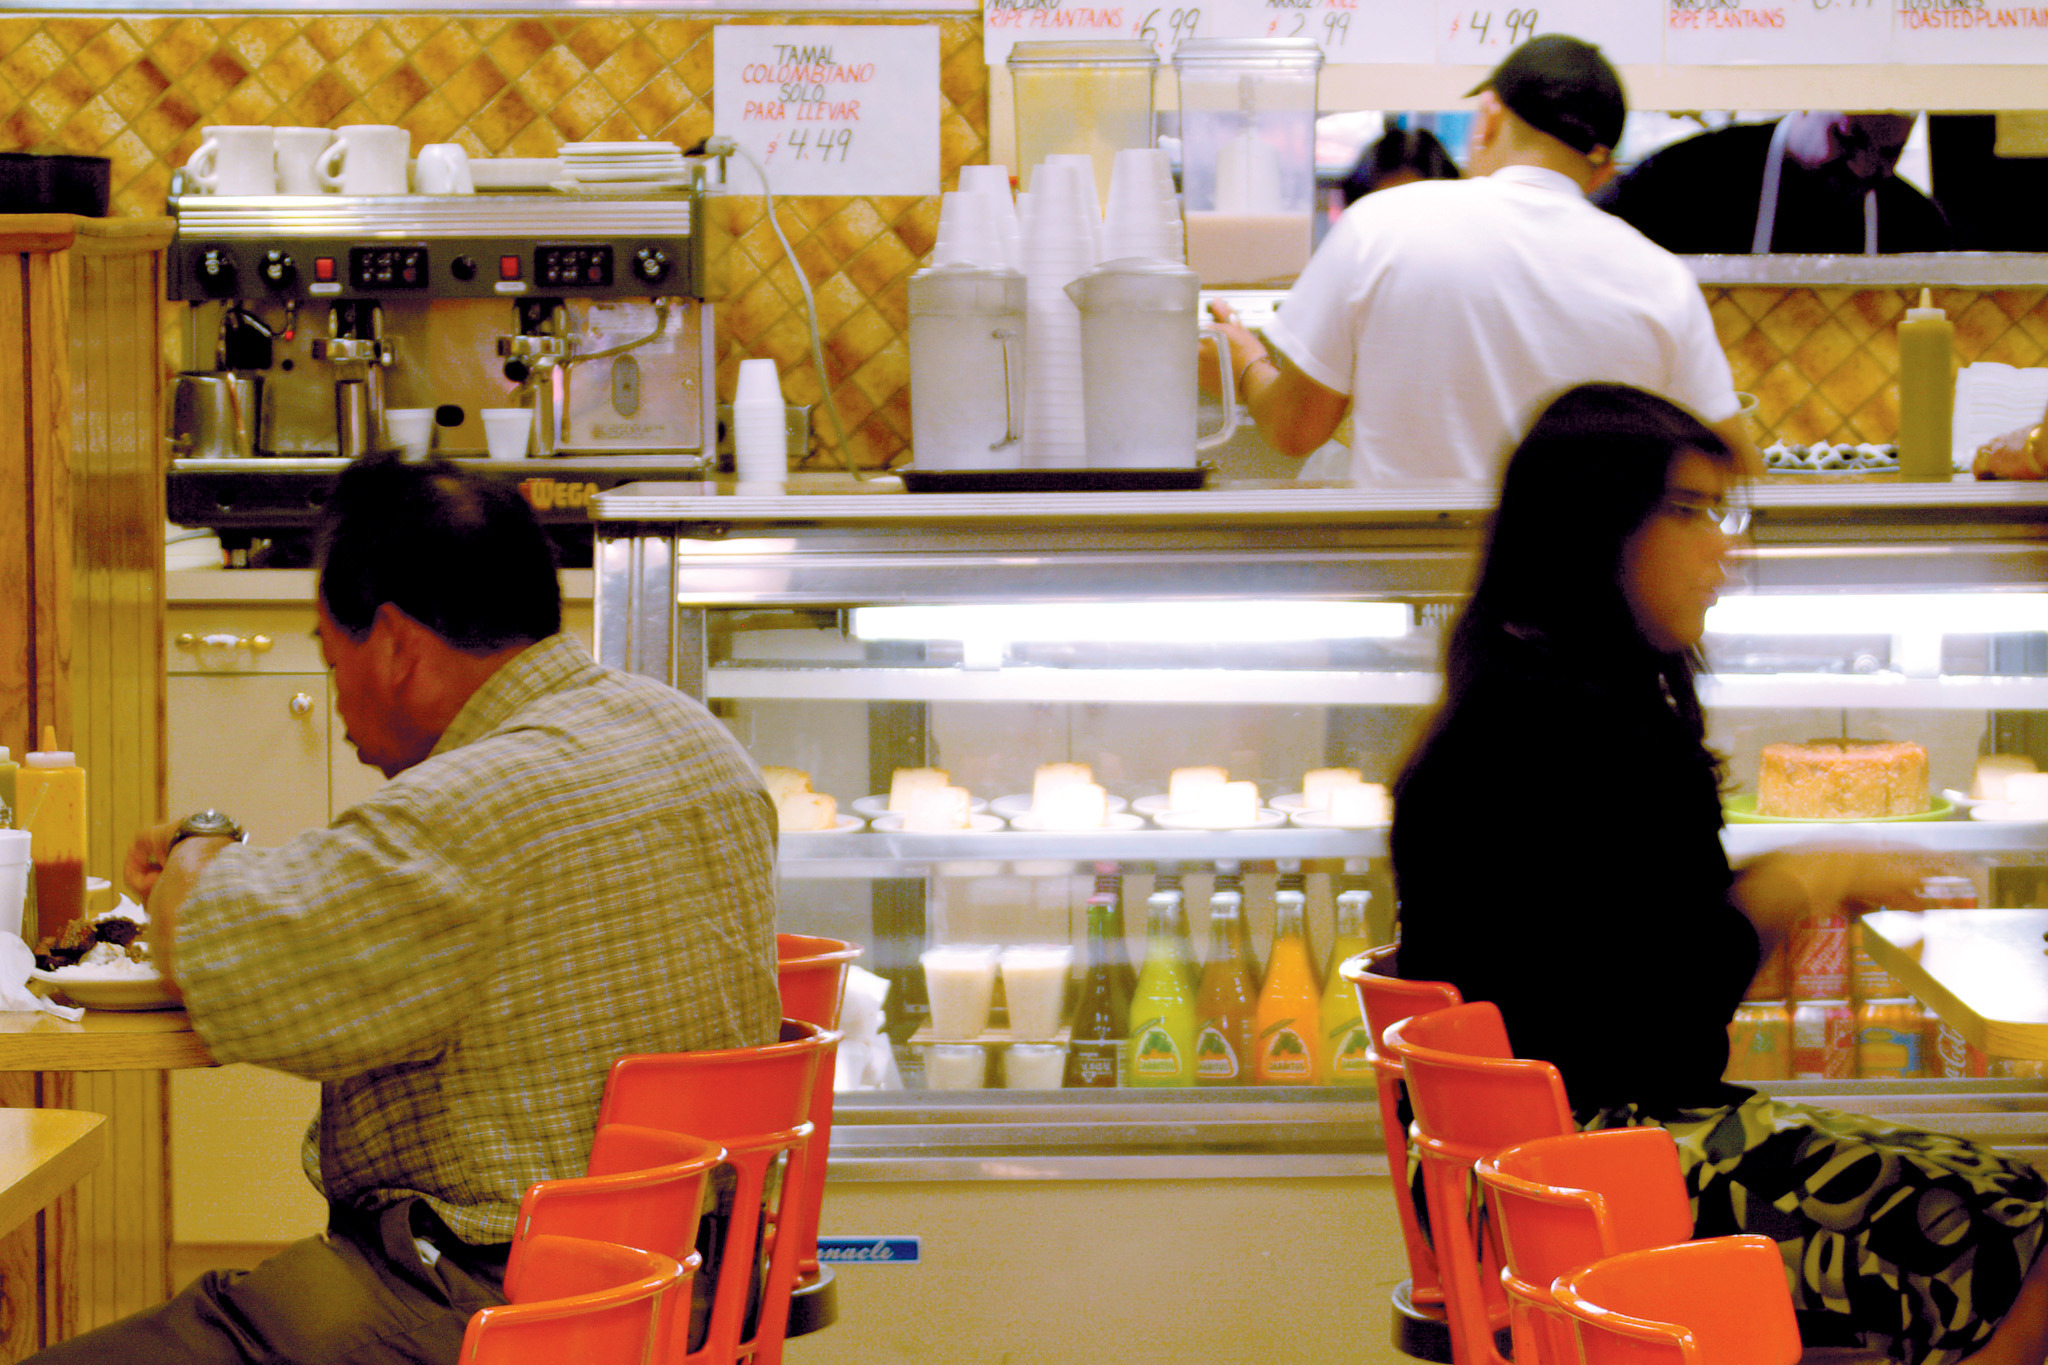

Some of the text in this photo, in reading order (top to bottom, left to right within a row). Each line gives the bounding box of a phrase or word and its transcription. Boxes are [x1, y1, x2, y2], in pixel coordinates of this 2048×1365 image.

[986, 7, 1123, 28] RIPE PLANTAINS
[1669, 7, 1786, 29] RIPE PLANTAINS
[1898, 9, 1974, 29] TOASTED
[772, 44, 837, 66] TAMAL
[741, 63, 875, 84] COLOMBIANO
[778, 83, 825, 104] SOLO
[743, 100, 861, 121] PARA LLEVAR
